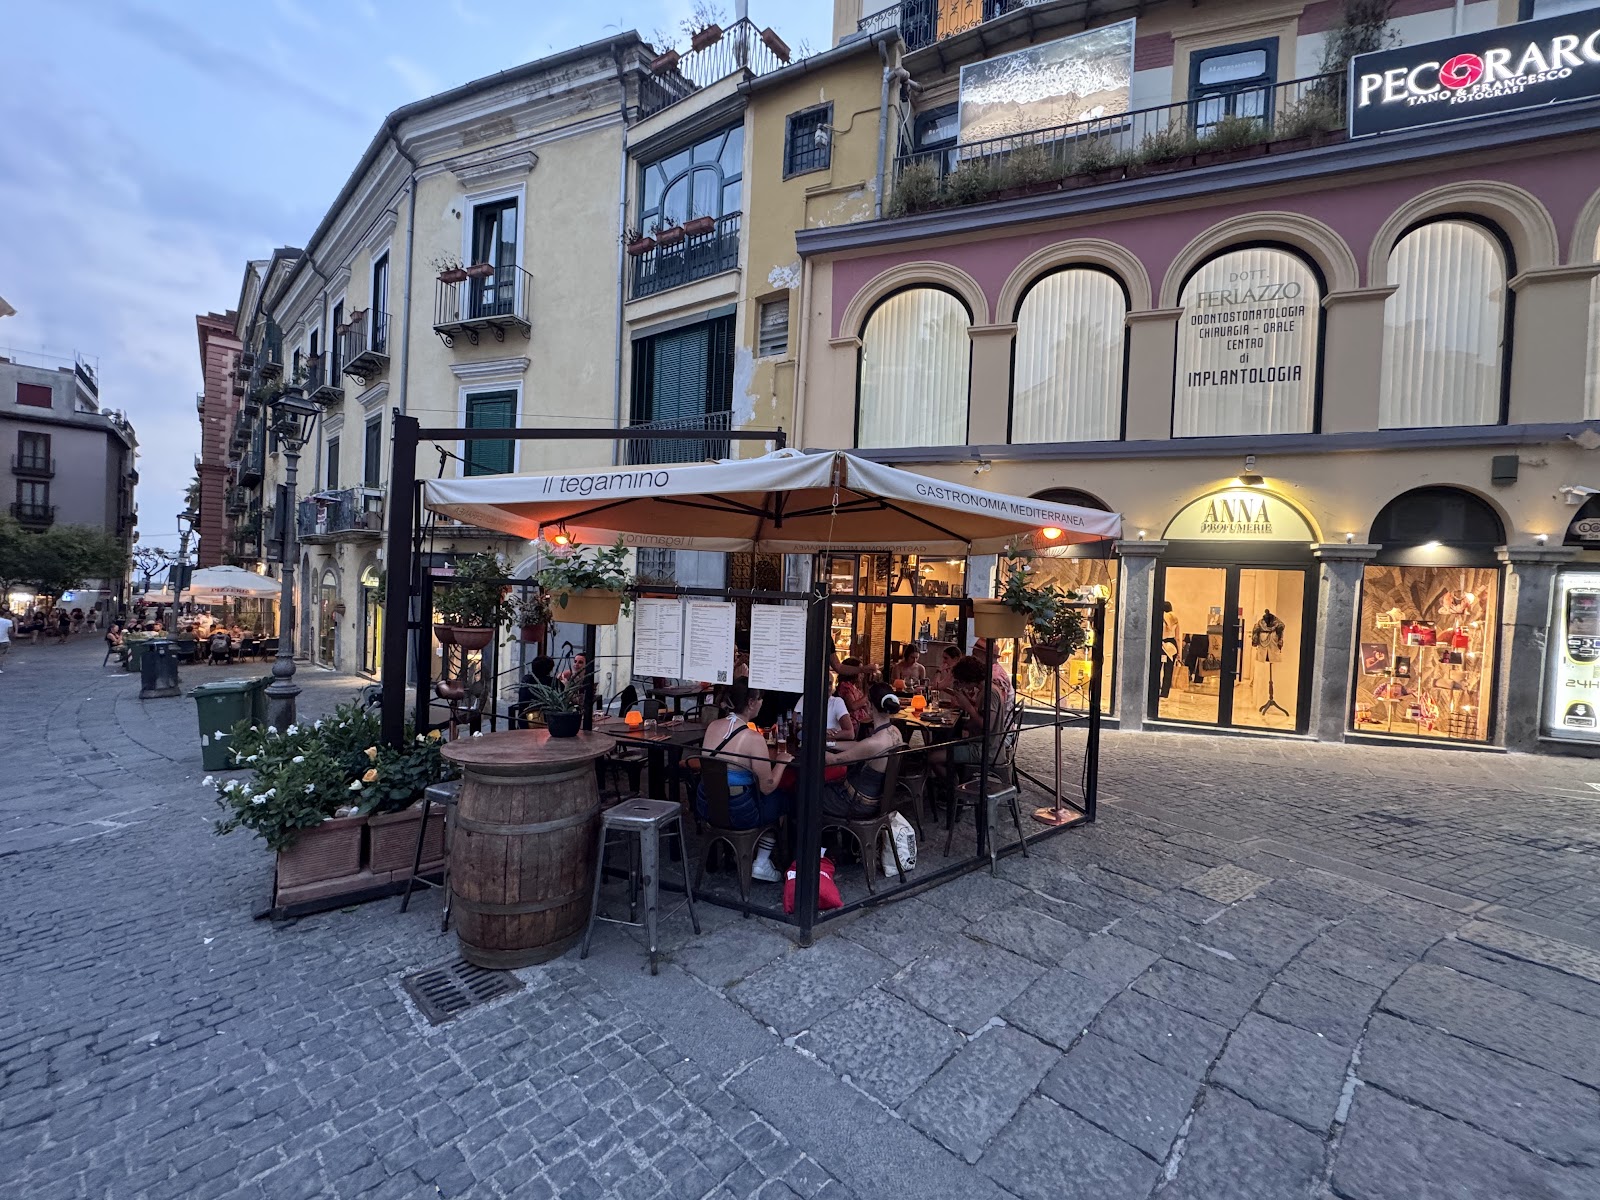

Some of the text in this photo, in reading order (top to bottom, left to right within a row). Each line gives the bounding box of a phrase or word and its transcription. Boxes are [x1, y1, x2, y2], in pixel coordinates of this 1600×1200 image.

[1208, 60, 1257, 73] MATRIMONI
[1406, 68, 1573, 106] TANO & FRANCESCO
[1450, 85, 1525, 105] FOTOGRAFI
[1229, 269, 1270, 283] DOTT.
[1197, 281, 1302, 308] FERLAZZO
[1191, 305, 1305, 326] ODONTOSTOMATOLOGIA
[1199, 324, 1249, 338] CHIRURGIA
[1263, 320, 1295, 334] ORALE
[1227, 337, 1263, 350] CENTRO
[1239, 352, 1249, 363] di
[1188, 365, 1302, 387] IMPLANTOLOGIA
[560, 470, 669, 496] tegamino
[916, 483, 1085, 527] GASTRONOMIA MEDITERRANEA
[1203, 498, 1270, 523] ANNA
[1202, 523, 1273, 533] PROFUMERIE
